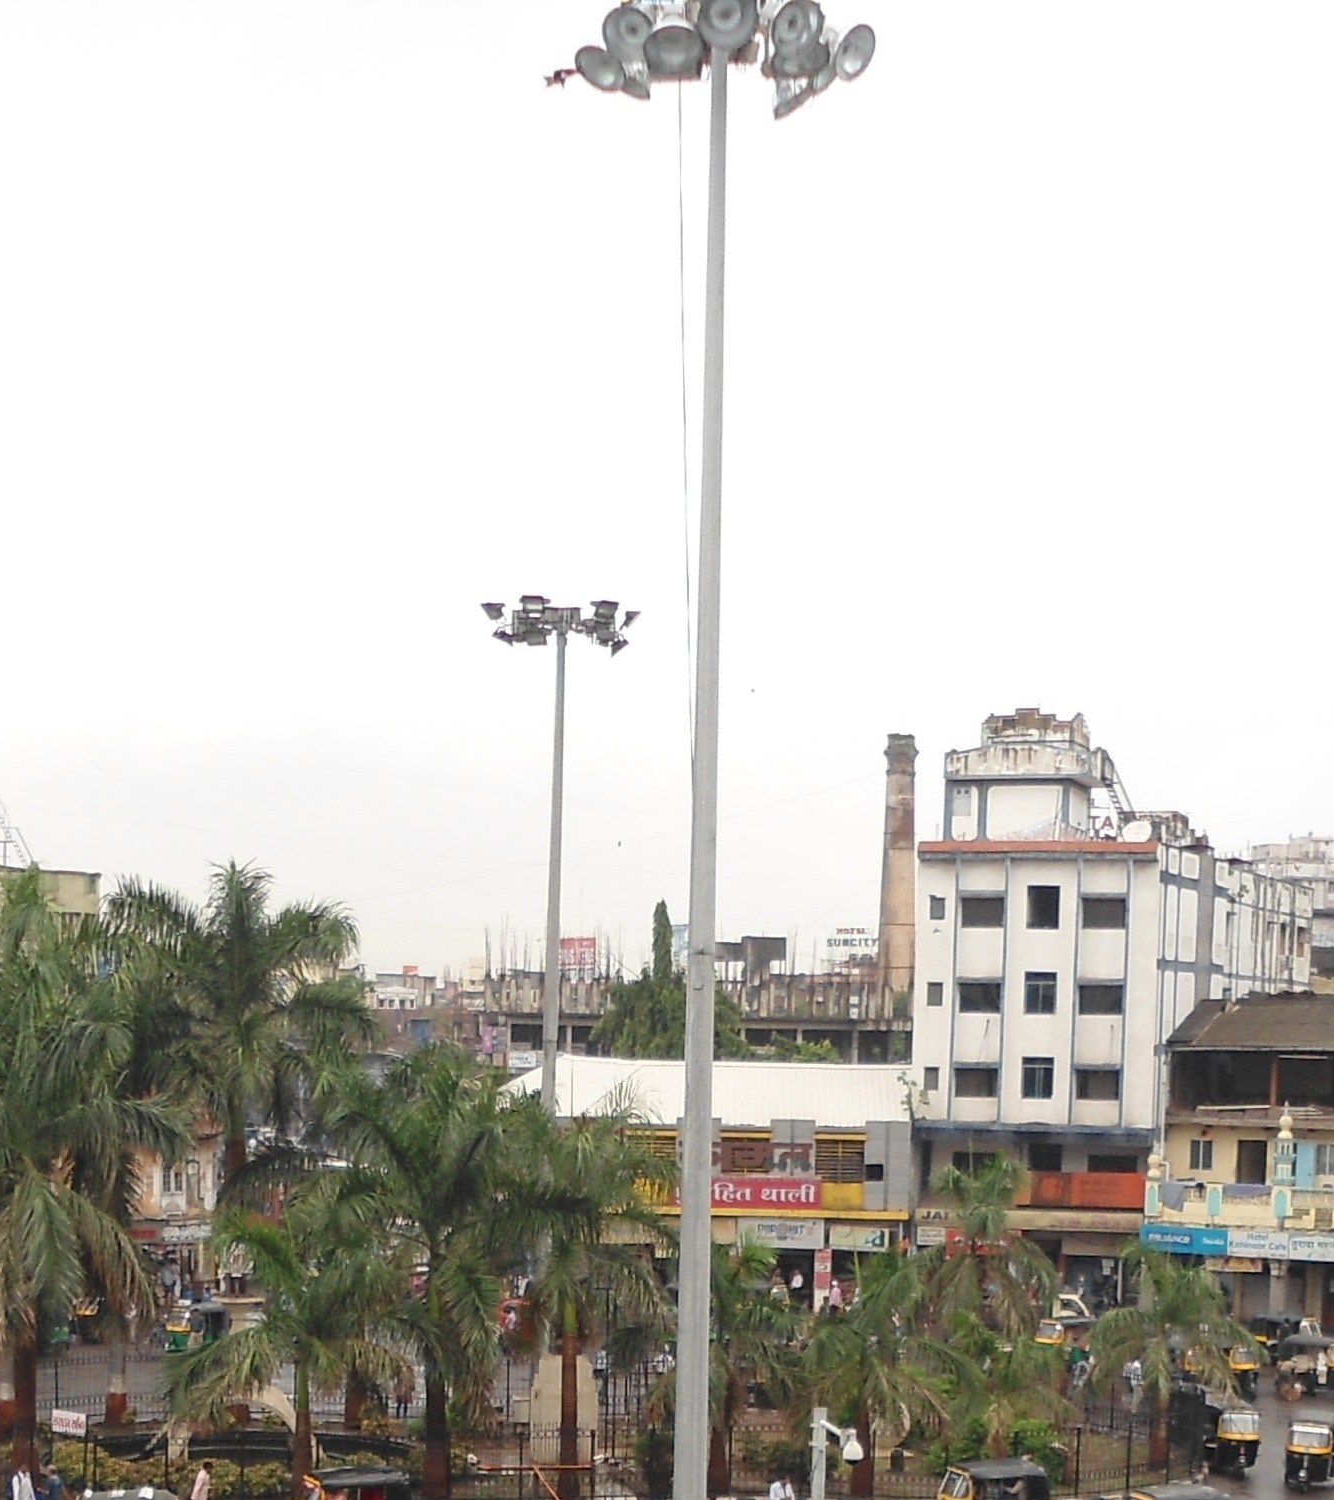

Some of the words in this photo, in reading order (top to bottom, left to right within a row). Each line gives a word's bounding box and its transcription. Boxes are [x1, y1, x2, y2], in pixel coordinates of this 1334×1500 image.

[826, 937, 878, 948] SUNCITY
[760, 1183, 816, 1204] थाली
[921, 1209, 948, 1221] JAI
[1246, 1232, 1268, 1241] Hotel
